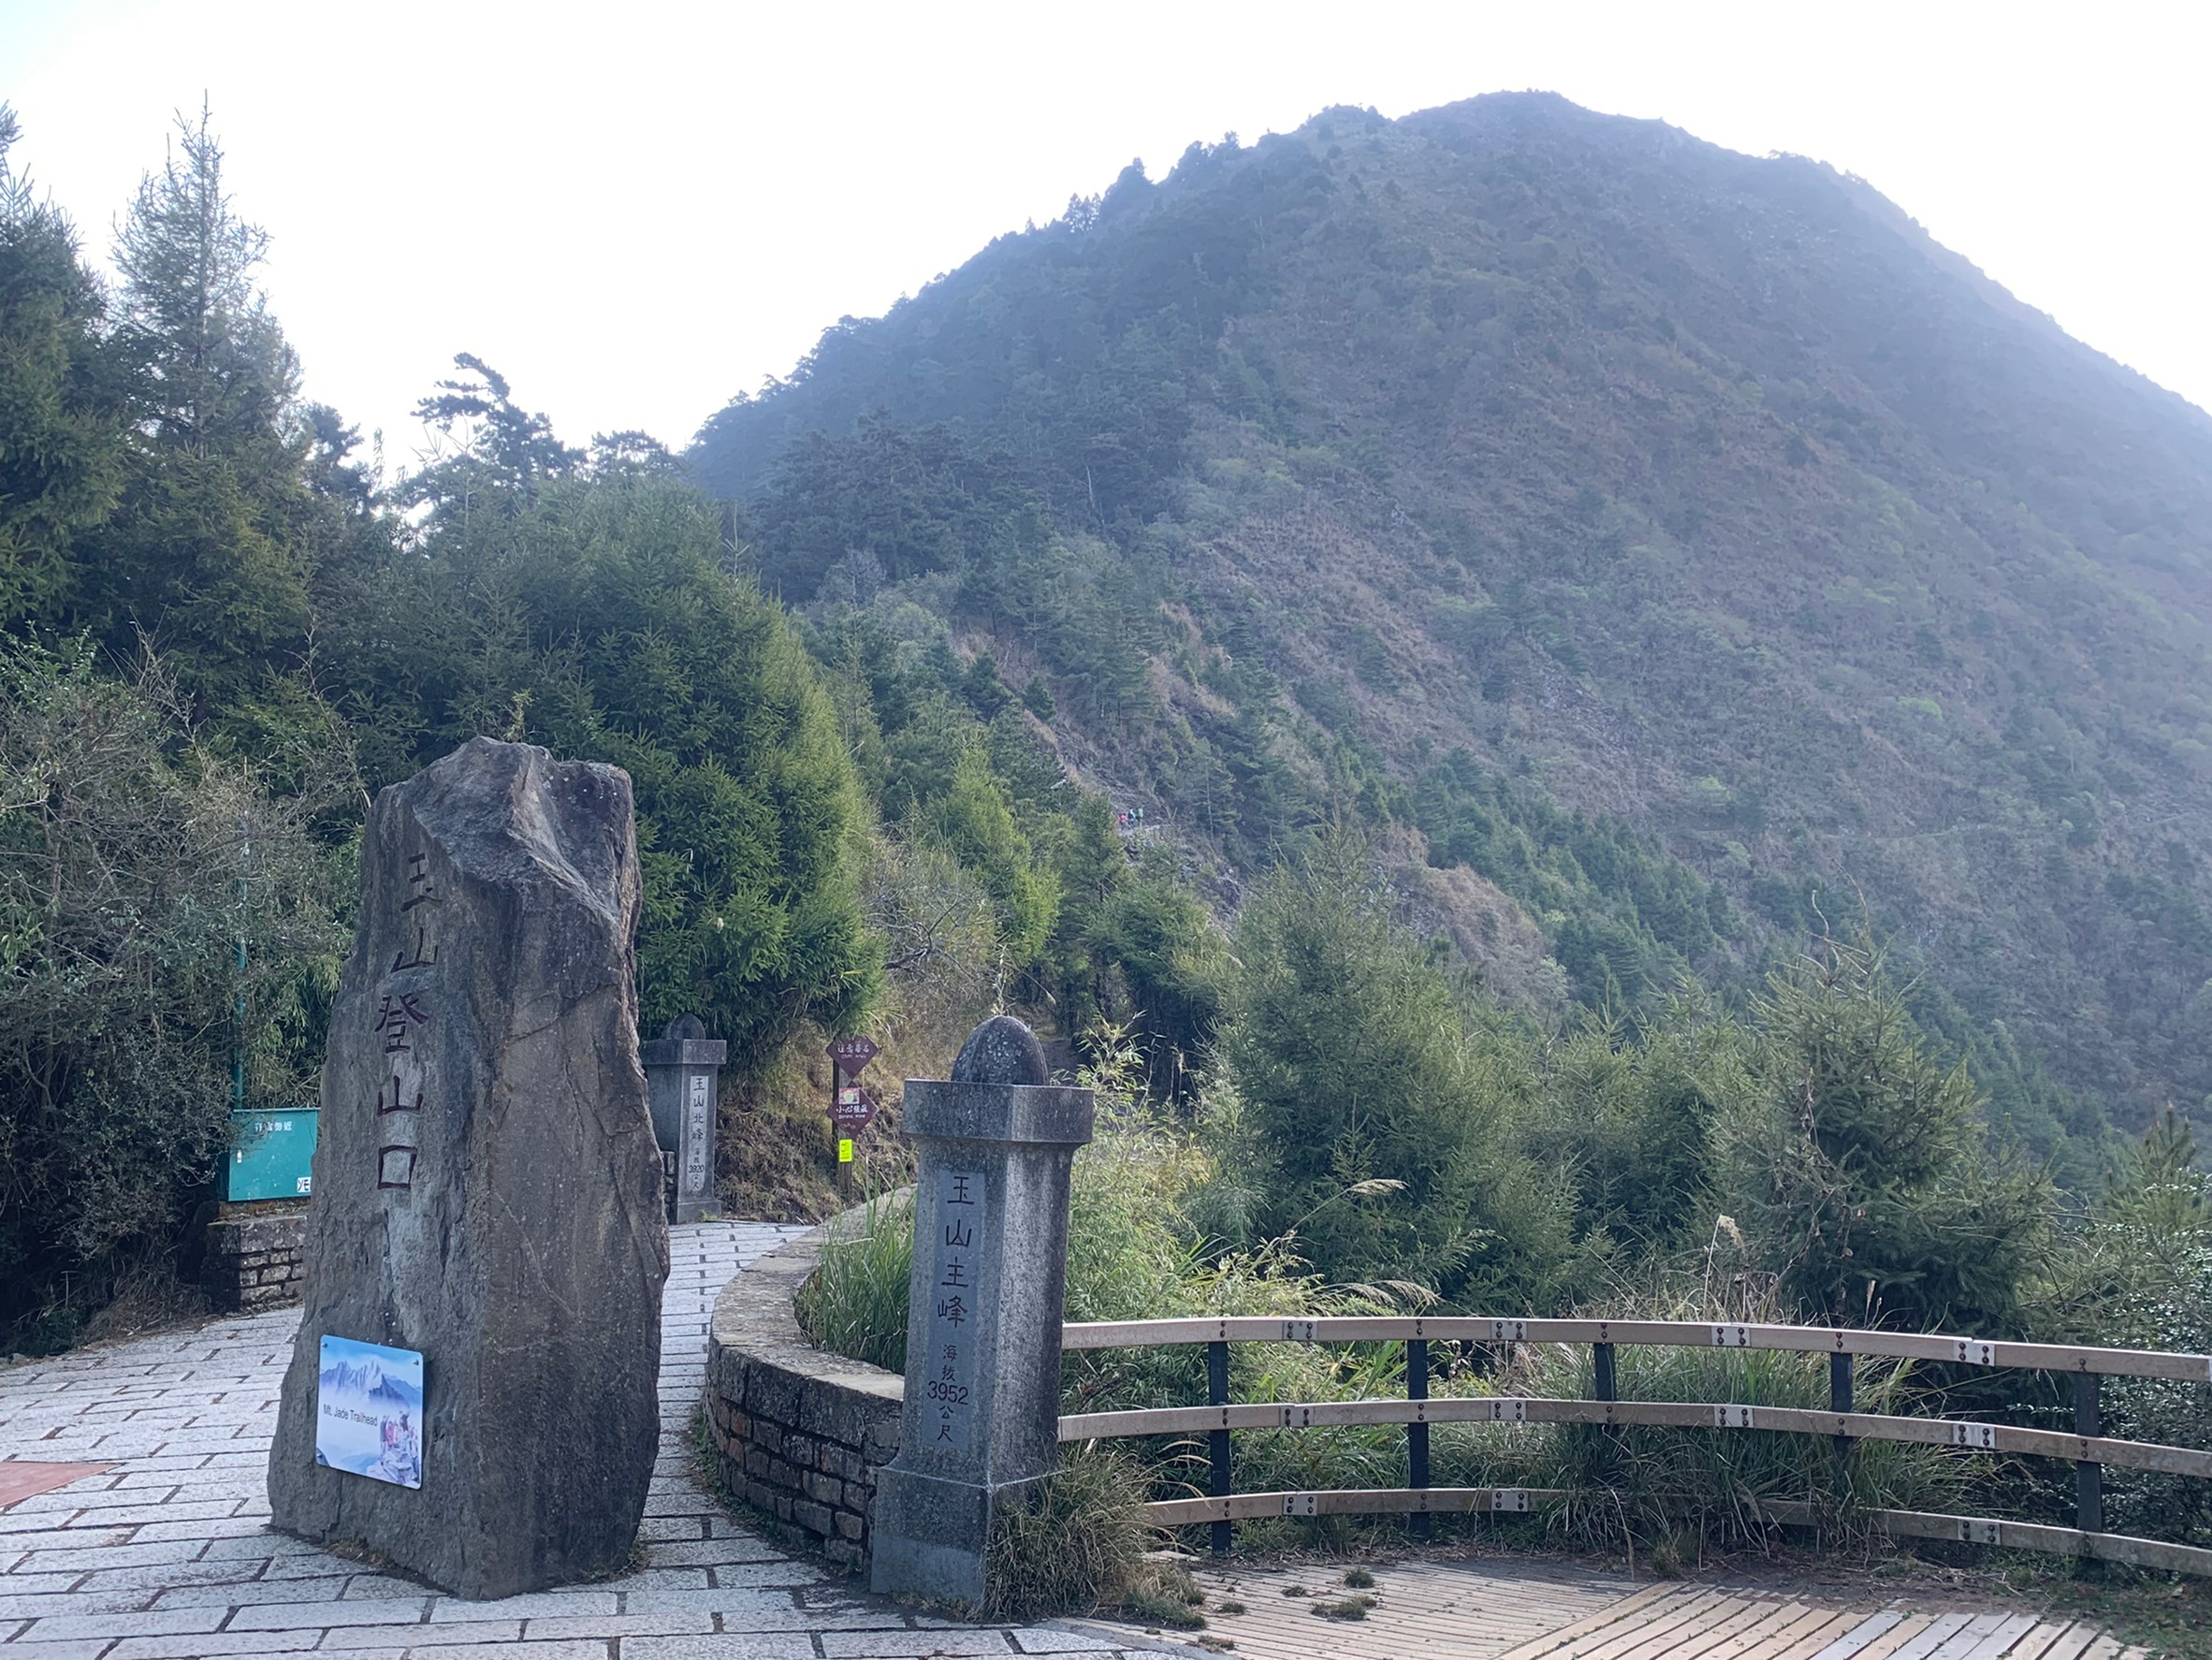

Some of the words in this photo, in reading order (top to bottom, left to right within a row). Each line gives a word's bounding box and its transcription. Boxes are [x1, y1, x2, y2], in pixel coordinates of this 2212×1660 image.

[374, 852, 443, 1190] 玉山登山口
[692, 1077, 706, 1142] 玉山北峰
[937, 1175, 975, 1329] 玉山主峰
[323, 1404, 333, 1416] Mt.
[334, 1408, 349, 1420] Jade
[350, 1409, 378, 1427] Trailhead
